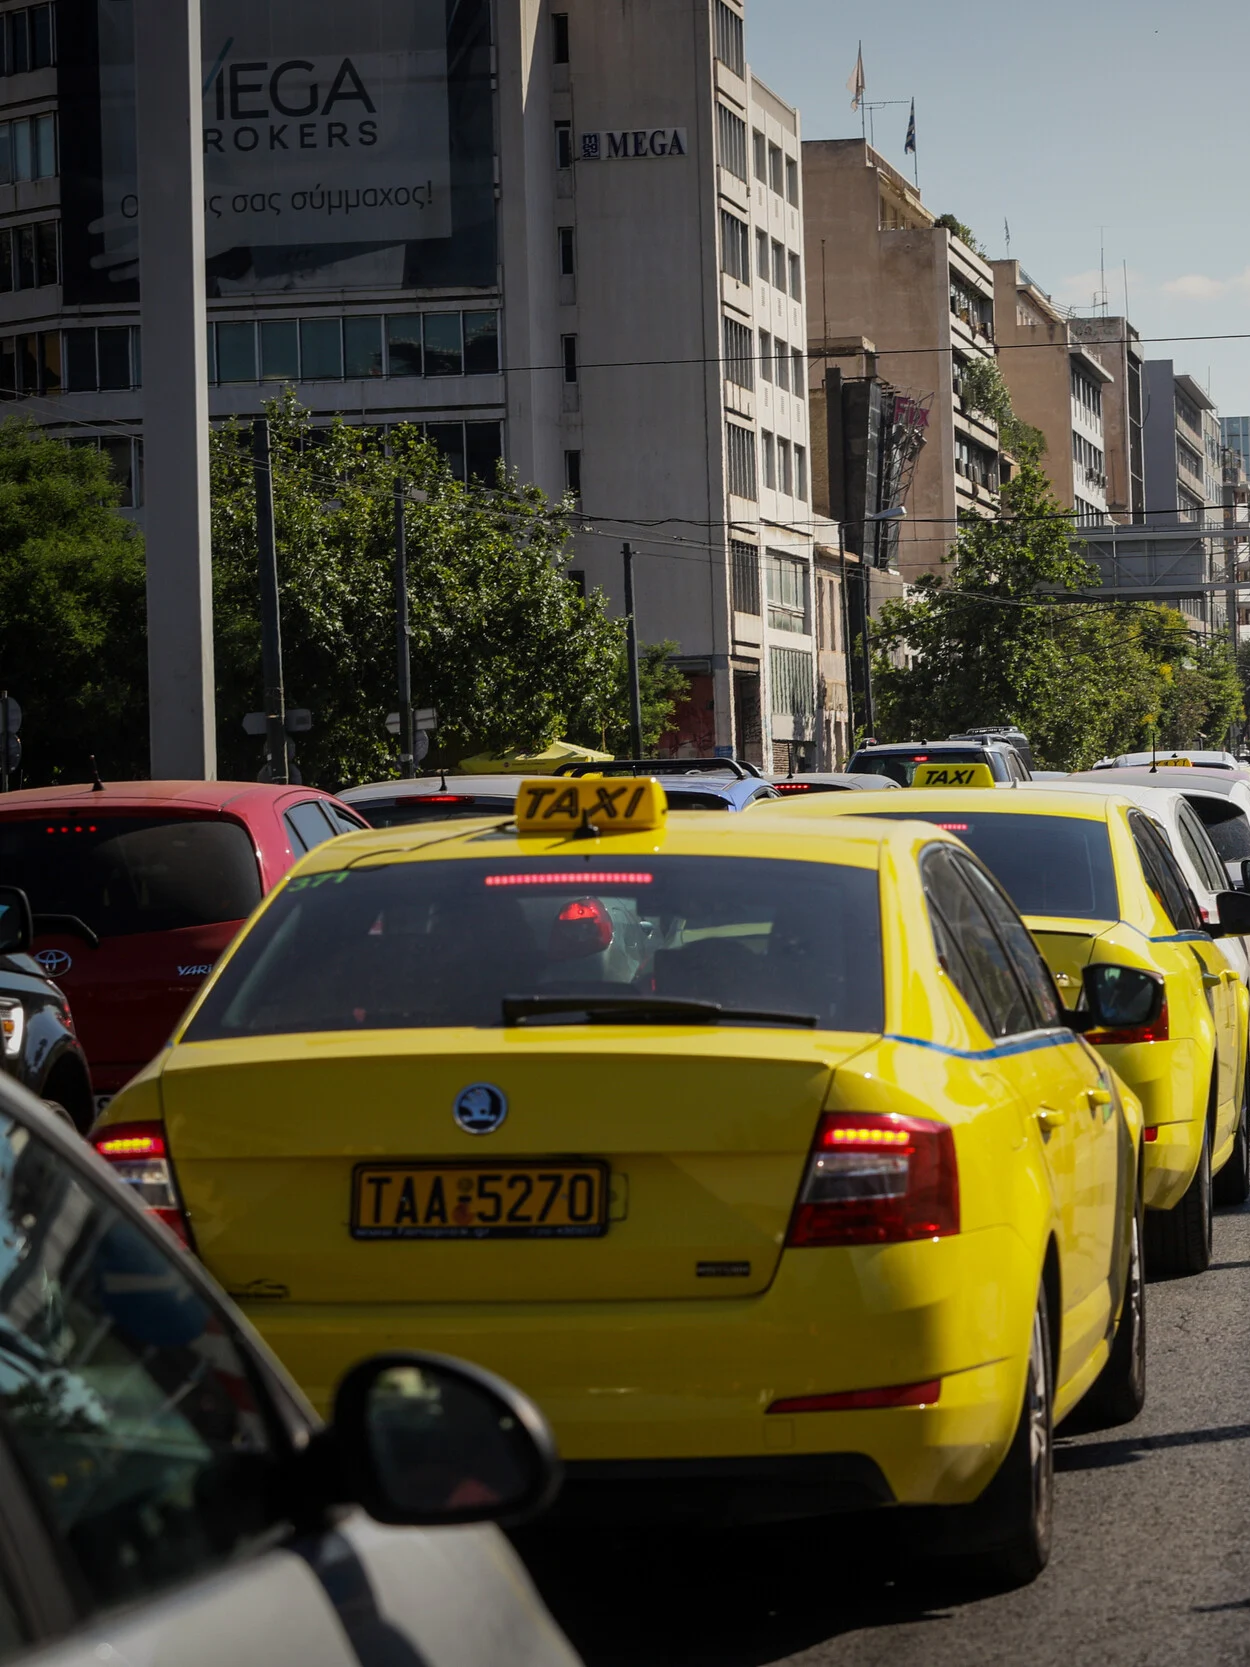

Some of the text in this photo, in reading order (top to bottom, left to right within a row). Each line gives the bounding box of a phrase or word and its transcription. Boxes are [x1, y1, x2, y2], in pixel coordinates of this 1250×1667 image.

[606, 129, 686, 159] MEGA
[231, 193, 281, 215] σας
[290, 180, 433, 215] σύμμαχος!
[925, 770, 975, 785] TAXI
[525, 786, 646, 819] TAXI
